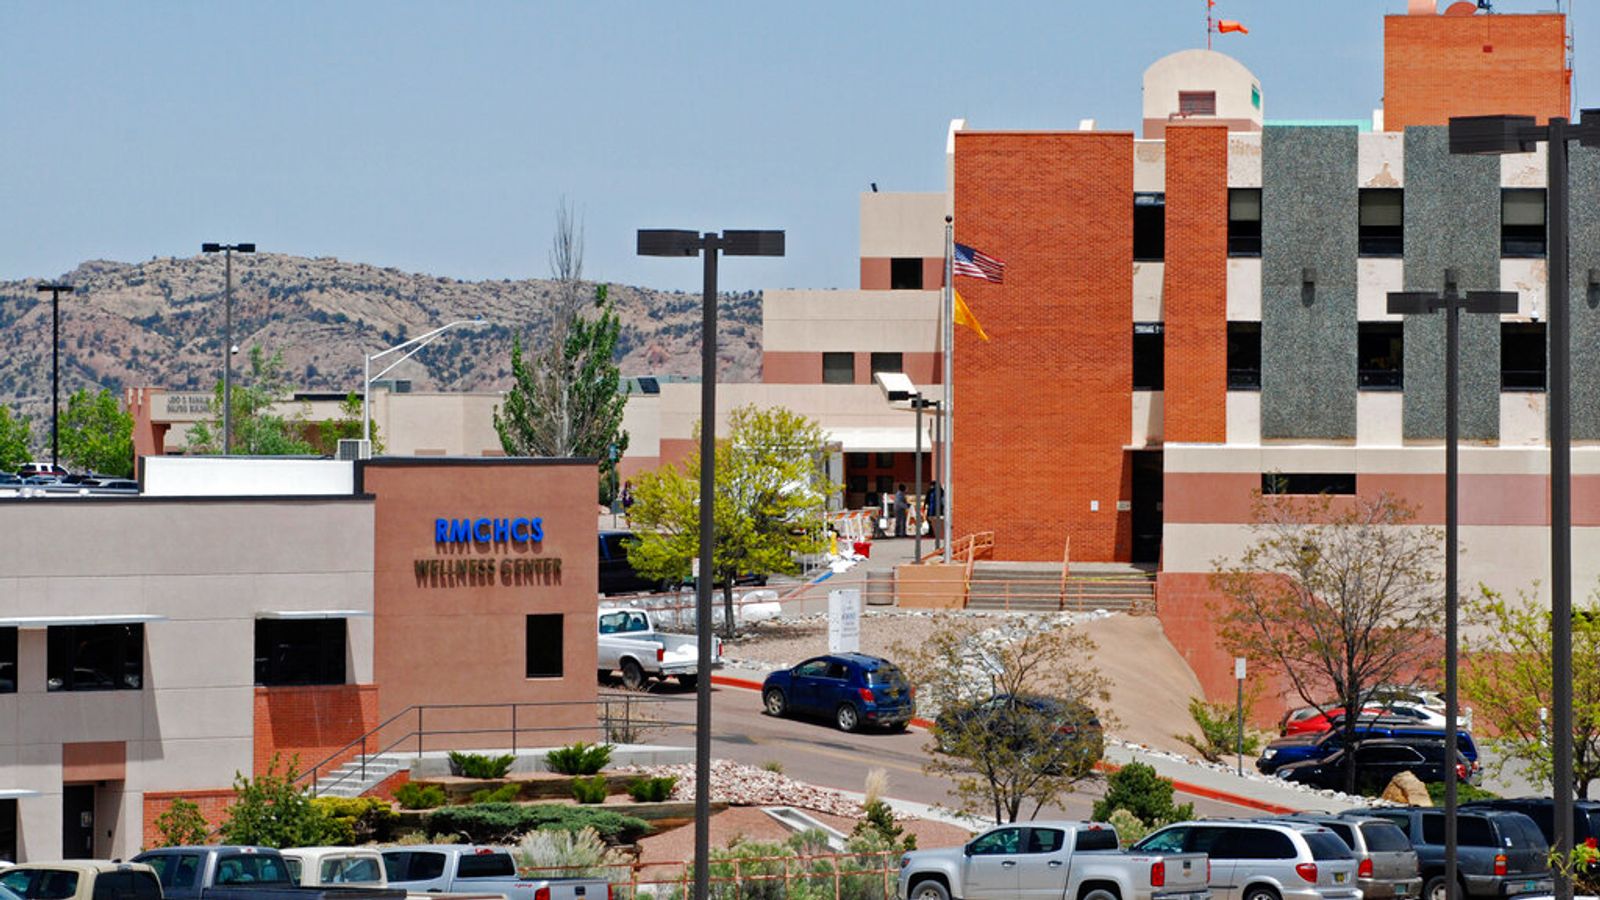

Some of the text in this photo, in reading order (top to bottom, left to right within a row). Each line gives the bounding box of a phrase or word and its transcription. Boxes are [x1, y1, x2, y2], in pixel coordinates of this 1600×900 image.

[435, 517, 544, 543] RMCHCS
[414, 557, 562, 581] WELLNESS CENTER
